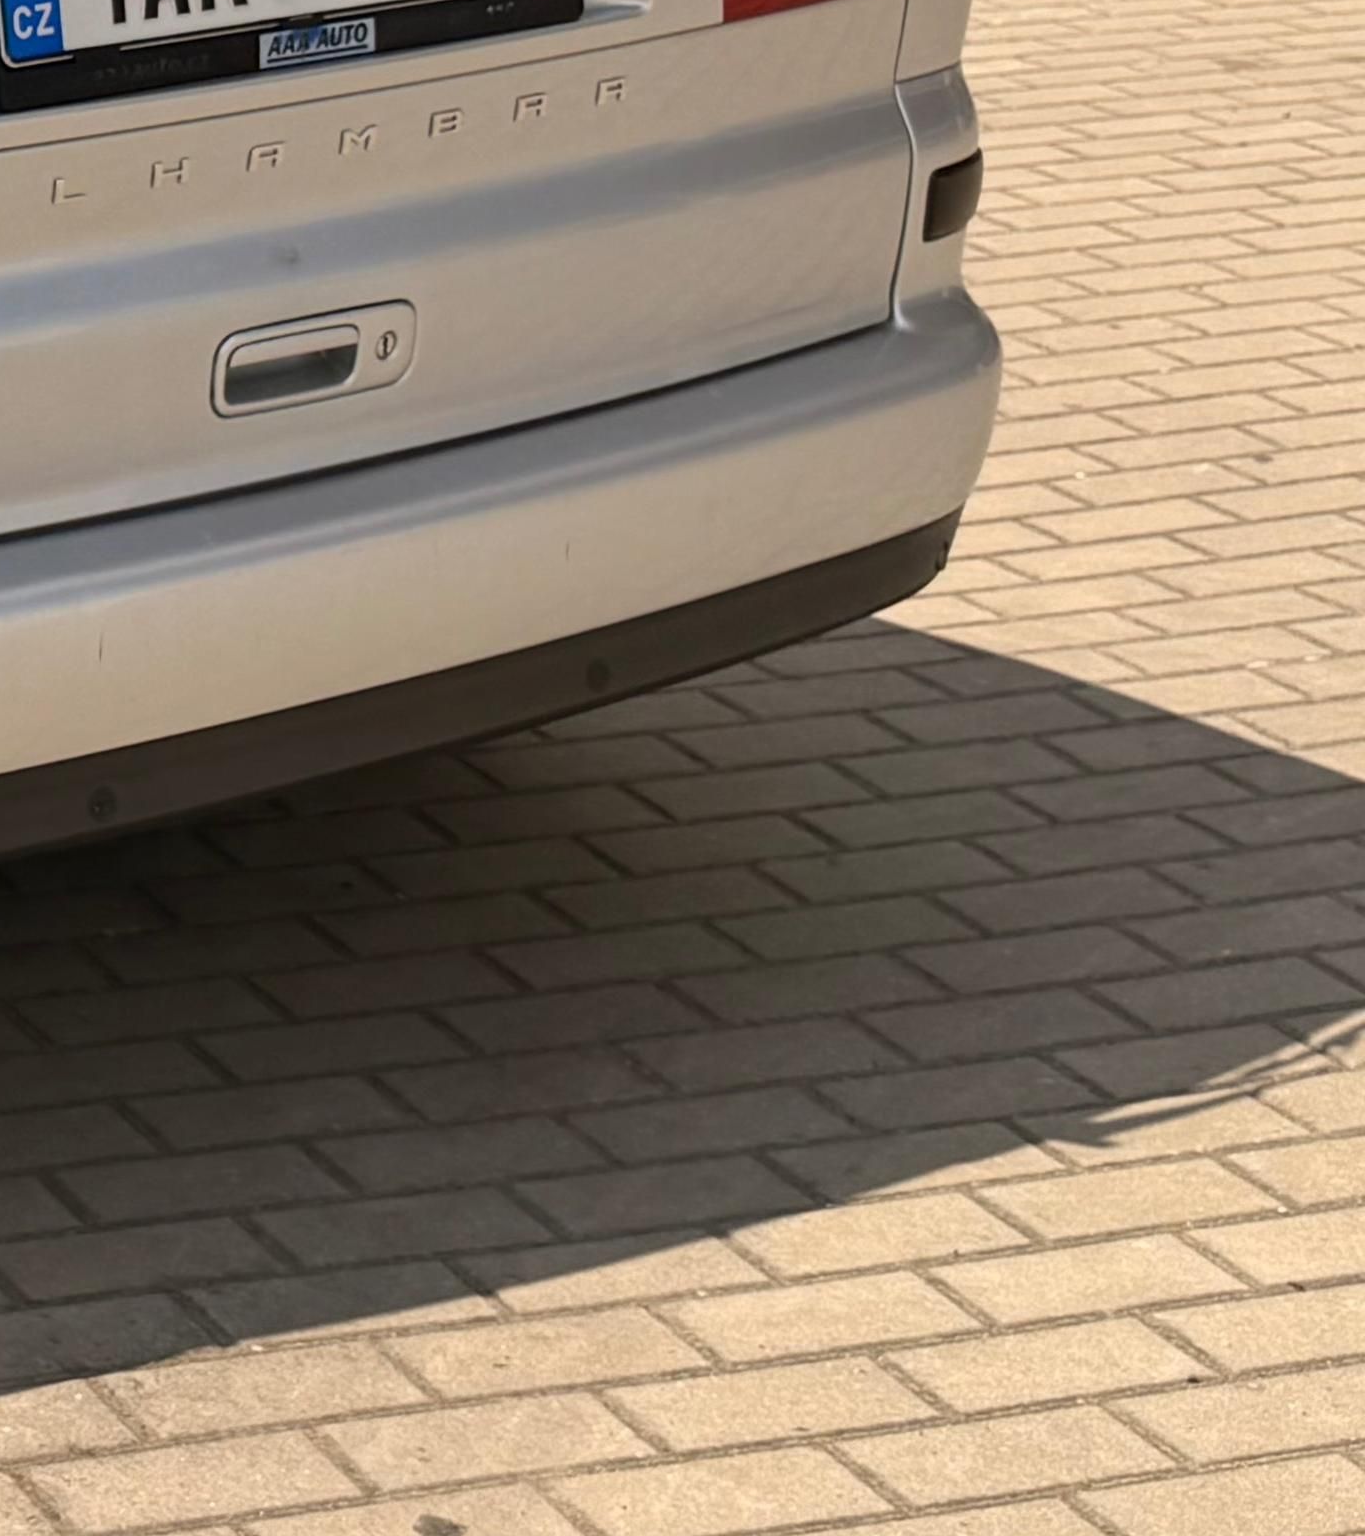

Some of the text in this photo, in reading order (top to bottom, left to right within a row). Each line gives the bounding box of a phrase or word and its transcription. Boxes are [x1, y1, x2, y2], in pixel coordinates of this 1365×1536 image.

[13, 2, 55, 39] CZ
[267, 22, 368, 57] AAA AUTO
